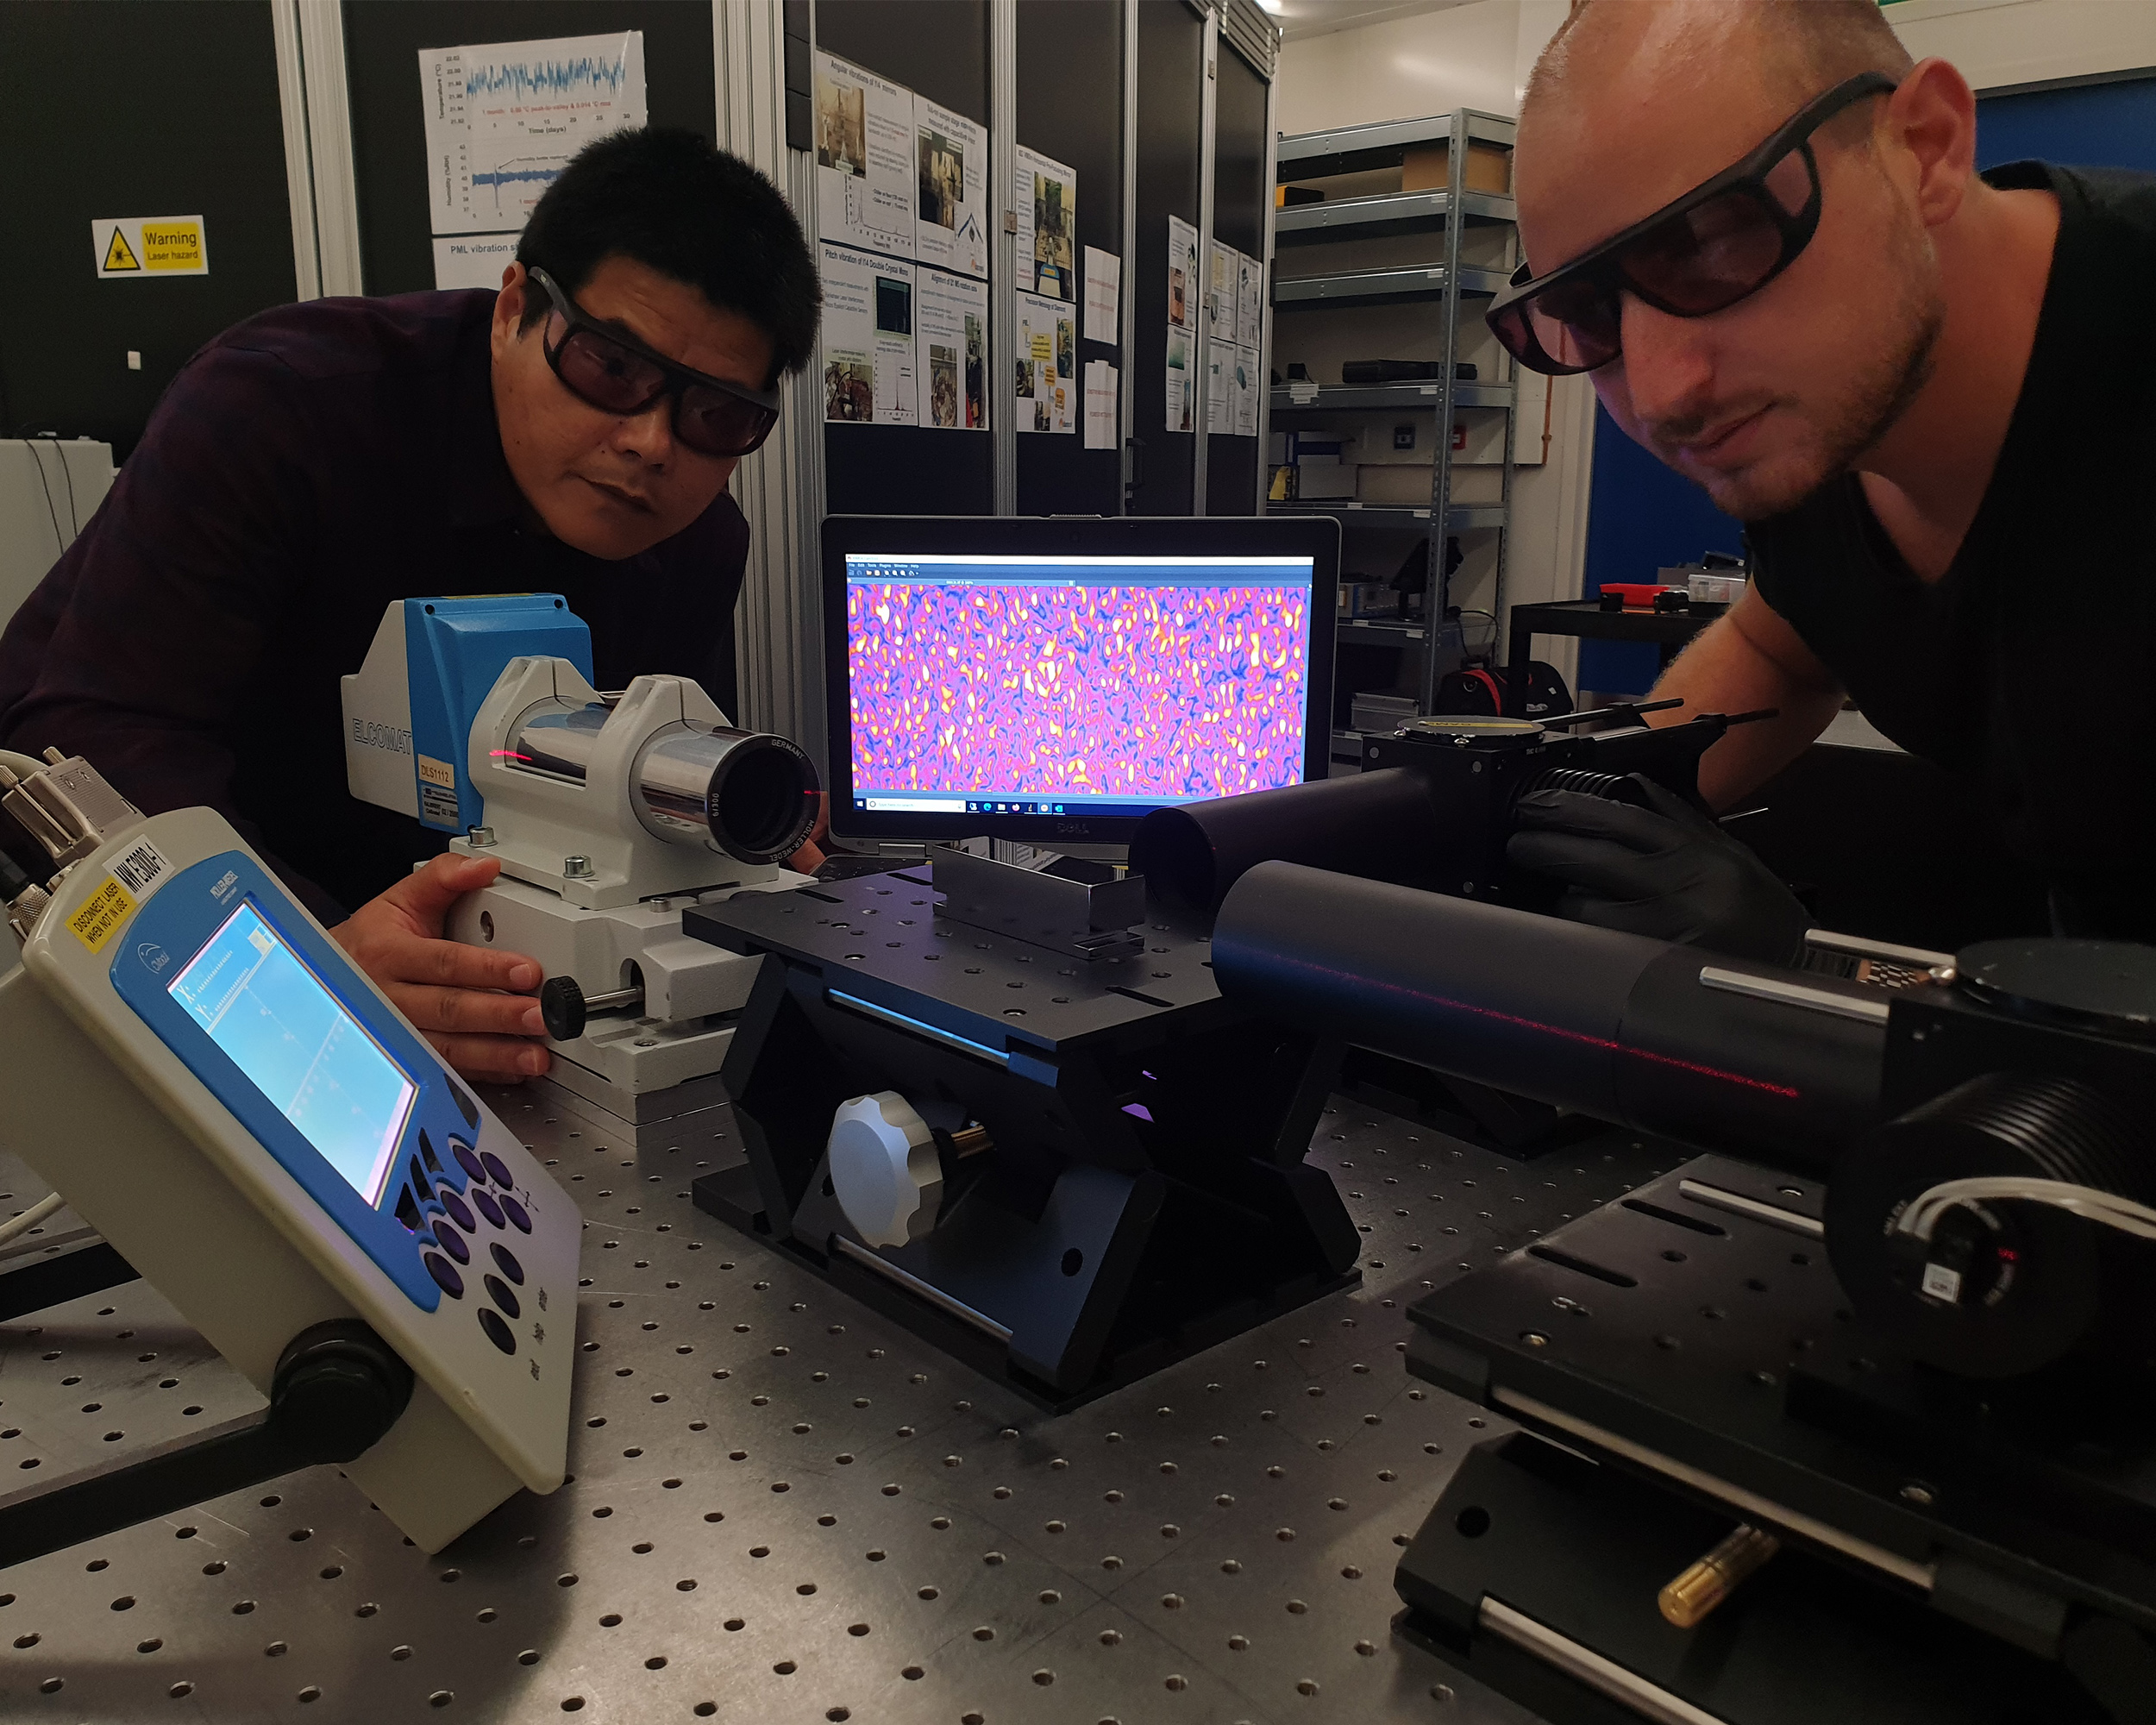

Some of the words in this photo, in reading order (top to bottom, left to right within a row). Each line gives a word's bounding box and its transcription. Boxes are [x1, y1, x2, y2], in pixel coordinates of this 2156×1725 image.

[546, 126, 567, 135] (days)
[145, 231, 197, 248] Warning
[147, 252, 169, 260] Laser
[172, 250, 198, 260] hazard
[450, 245, 468, 254] PML
[471, 244, 507, 253] vibration
[824, 248, 838, 259] Pitch
[838, 252, 857, 264] vibration
[869, 259, 885, 270] Double
[885, 262, 898, 274] Crystal
[352, 718, 412, 756] ELCOMAT
[771, 739, 805, 760] GERMANY
[421, 764, 449, 782] DLS1112
[72, 895, 107, 933] DISCONNECT
[100, 881, 121, 902] LASER
[107, 906, 119, 919] IN
[112, 896, 128, 913] USE
[97, 912, 115, 930] NOT
[85, 923, 105, 944] WHEN
